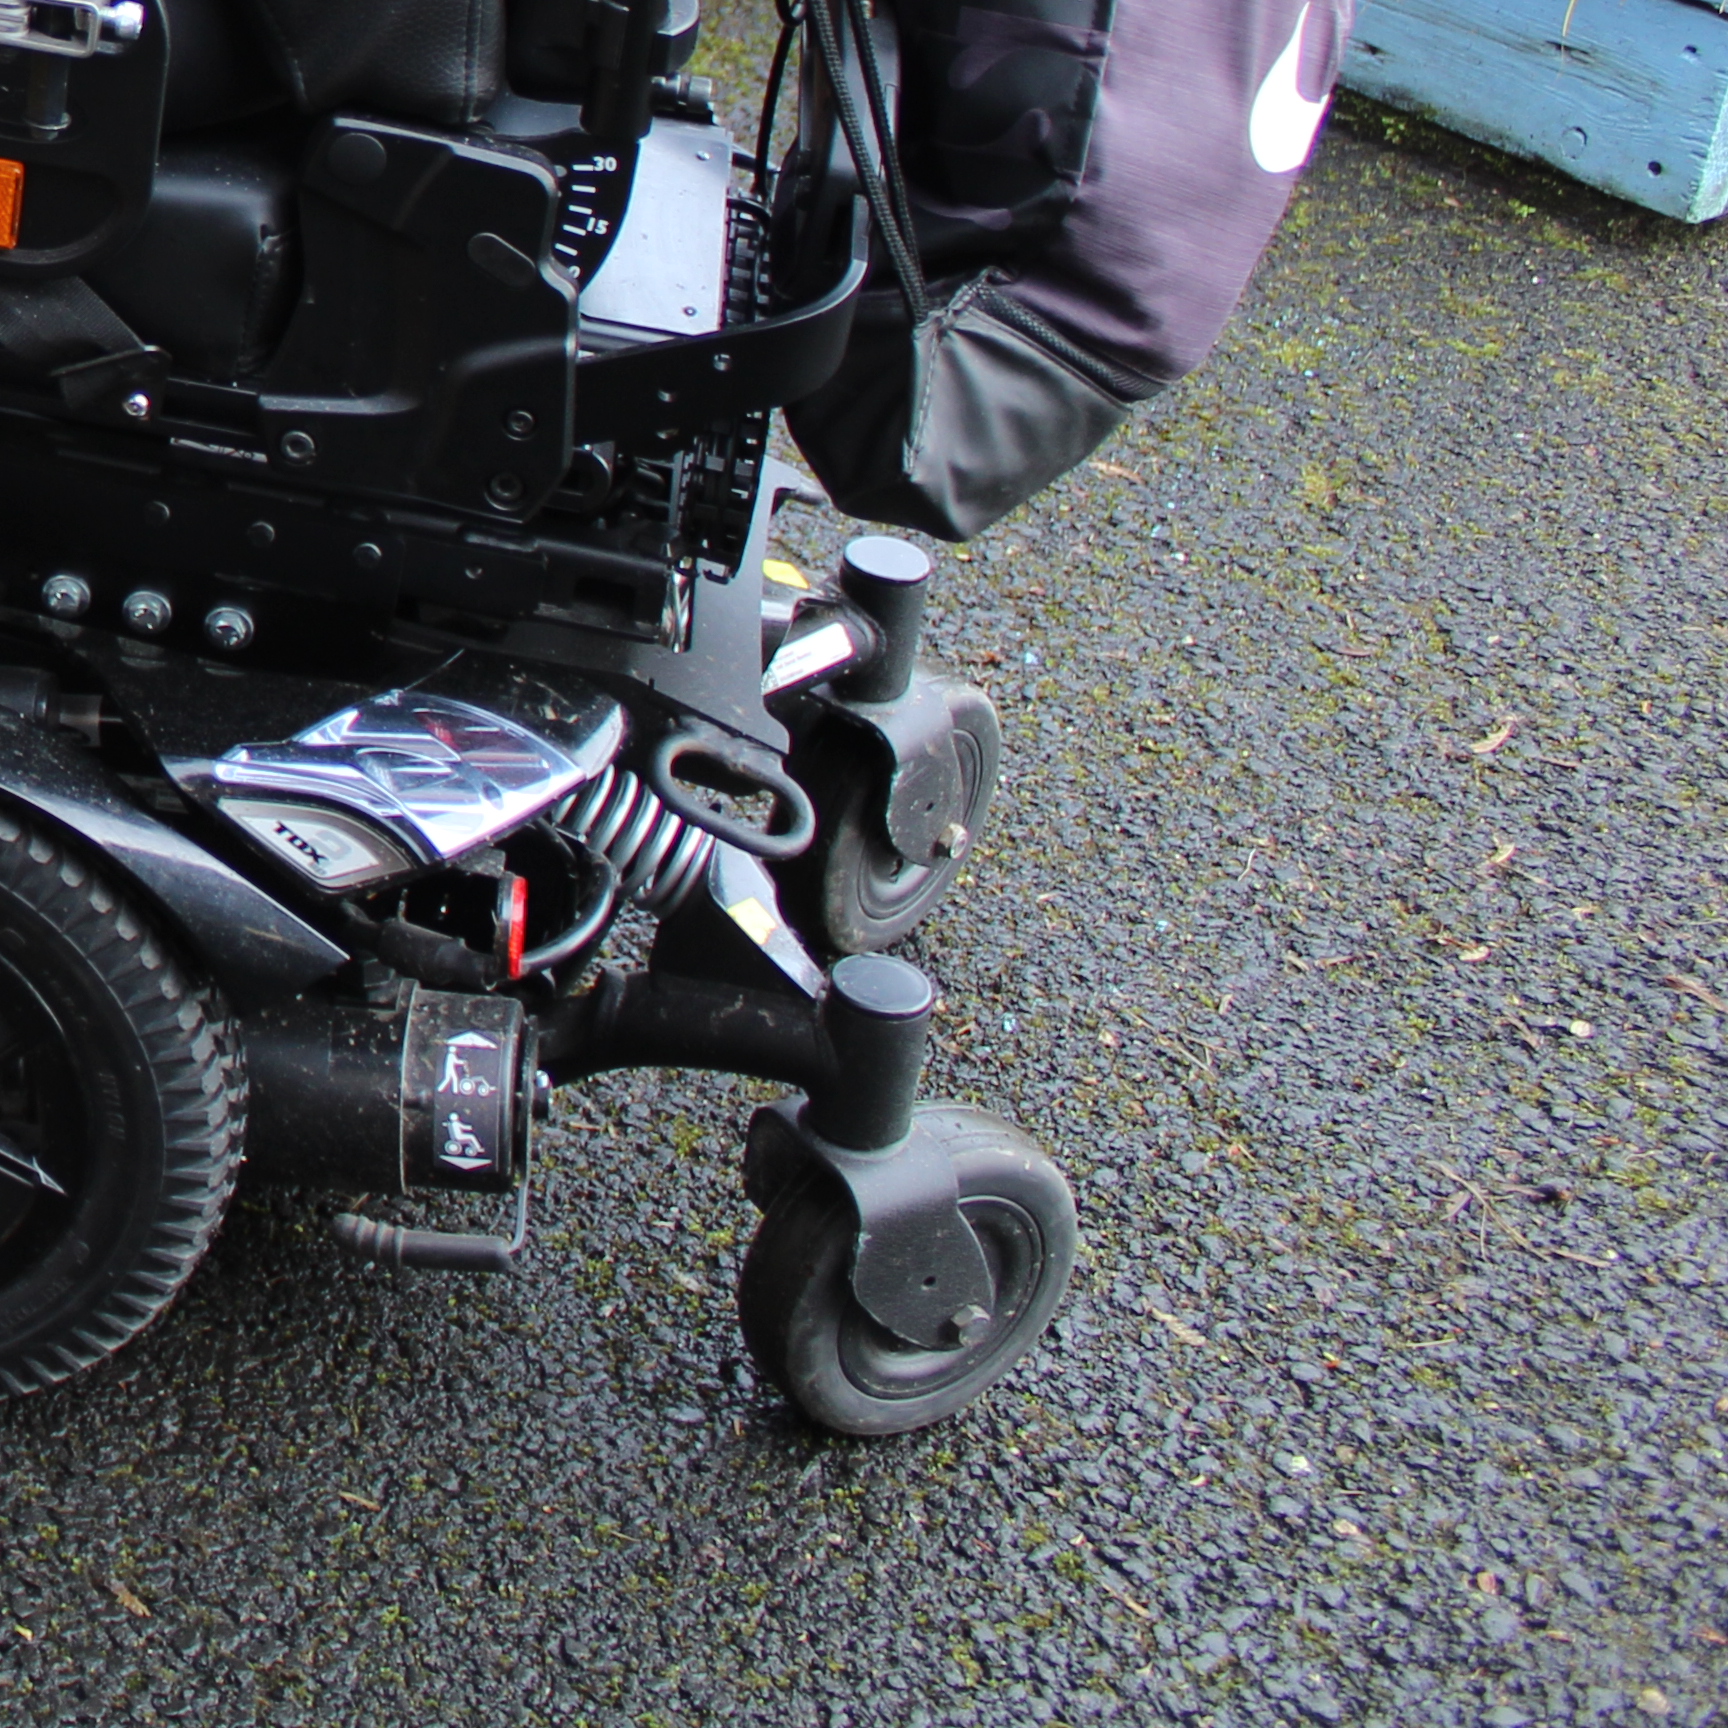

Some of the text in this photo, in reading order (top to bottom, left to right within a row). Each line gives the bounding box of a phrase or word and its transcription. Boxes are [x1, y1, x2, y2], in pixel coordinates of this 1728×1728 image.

[593, 156, 617, 172] 30
[586, 216, 609, 235] 15
[275, 821, 327, 863] TDX
